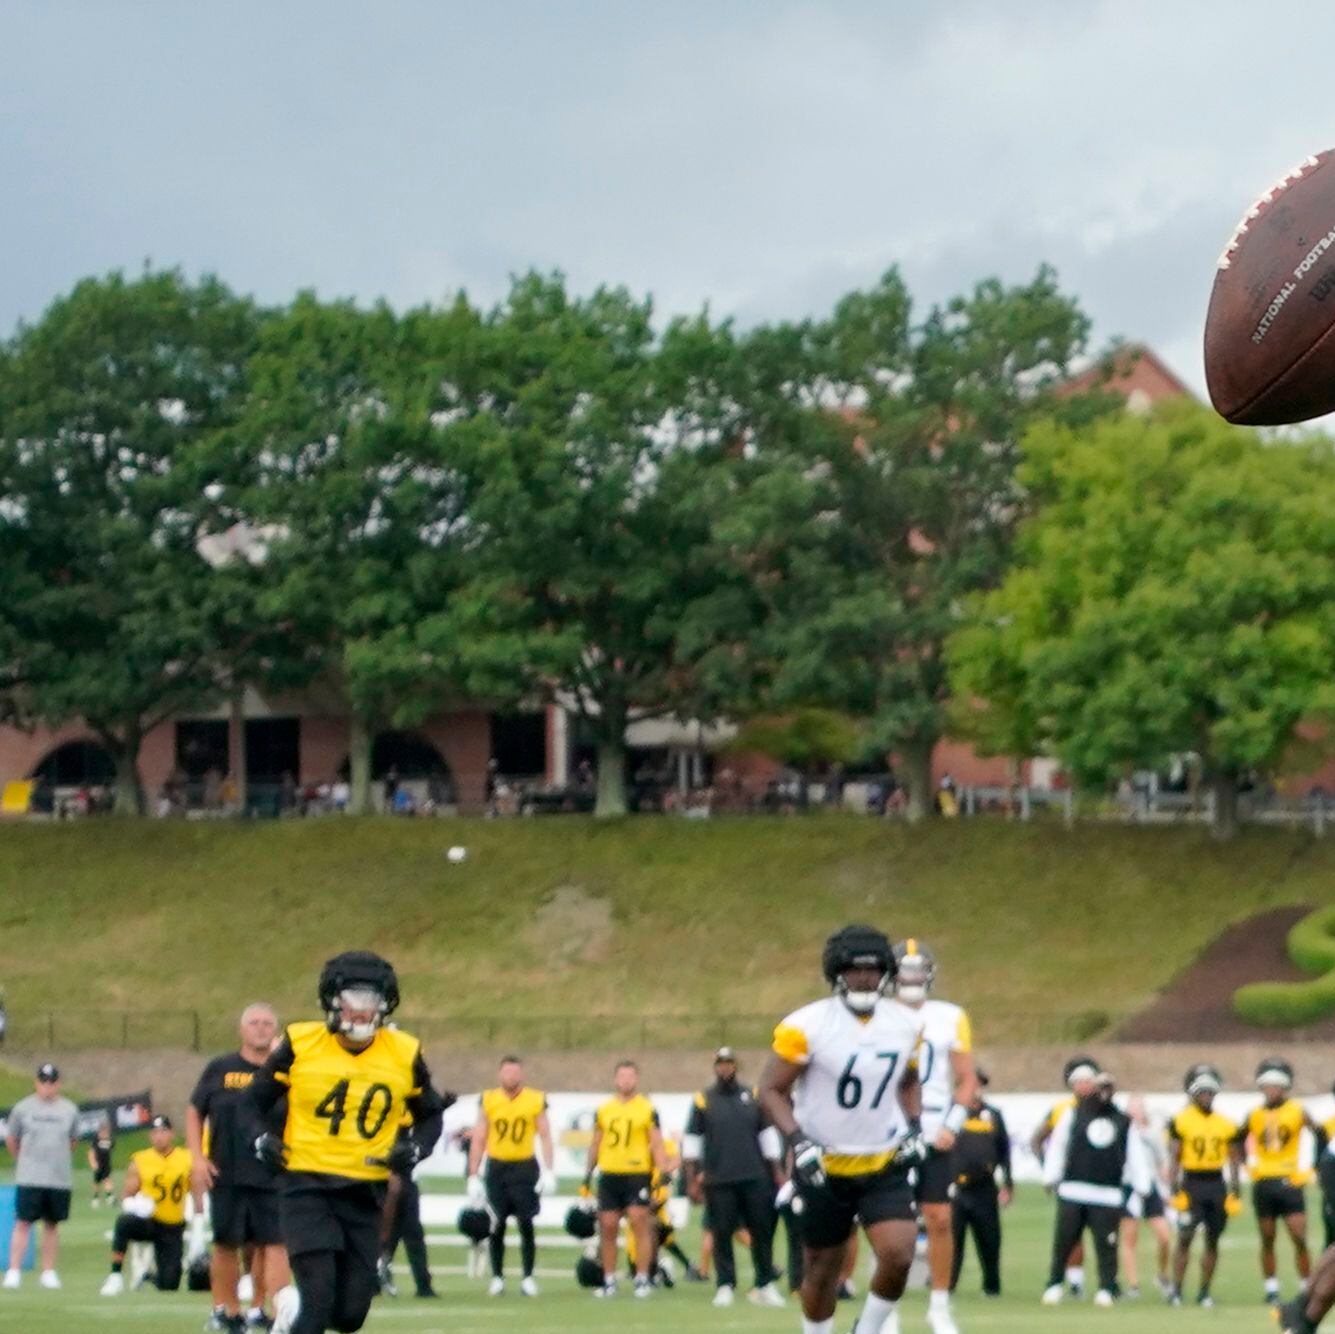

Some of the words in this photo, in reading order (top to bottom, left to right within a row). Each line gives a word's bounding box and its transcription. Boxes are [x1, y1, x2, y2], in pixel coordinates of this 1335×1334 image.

[1252, 281, 1297, 344] NATIONAL
[837, 1051, 899, 1110] 67
[314, 1079, 393, 1140] 40
[494, 1117, 528, 1145] 90
[608, 1118, 633, 1148] 51
[152, 1173, 184, 1204] 56
